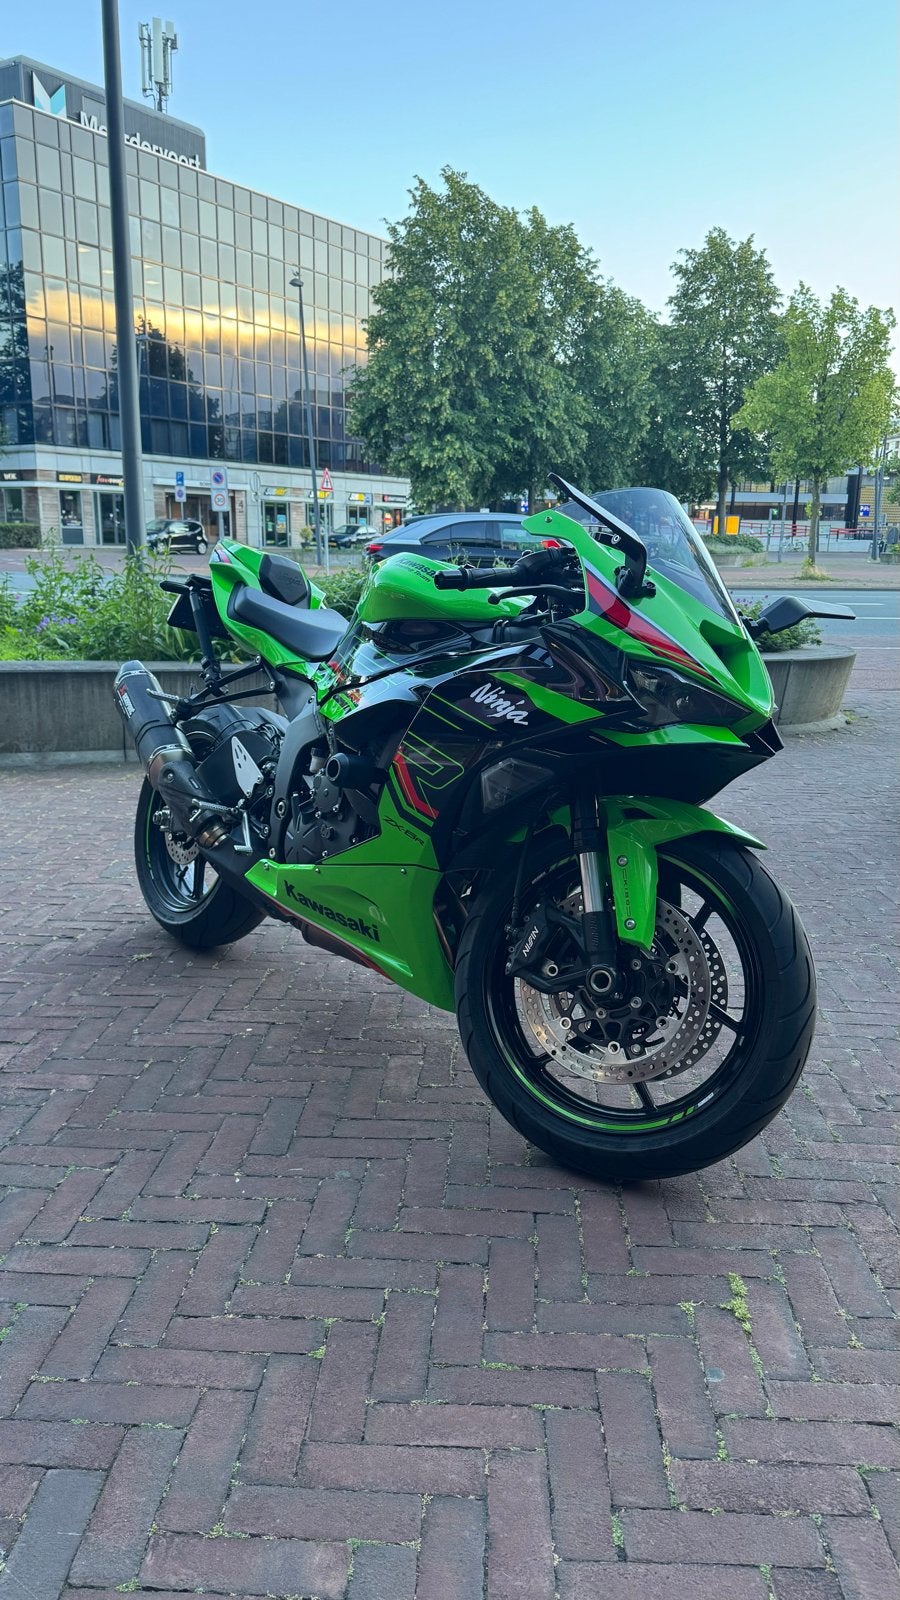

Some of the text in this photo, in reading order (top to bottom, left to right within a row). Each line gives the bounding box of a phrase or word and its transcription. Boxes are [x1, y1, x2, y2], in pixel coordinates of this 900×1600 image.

[470, 683, 528, 725] Ninja
[284, 880, 380, 942] Kawasaki
[522, 925, 539, 958] NISSIN
